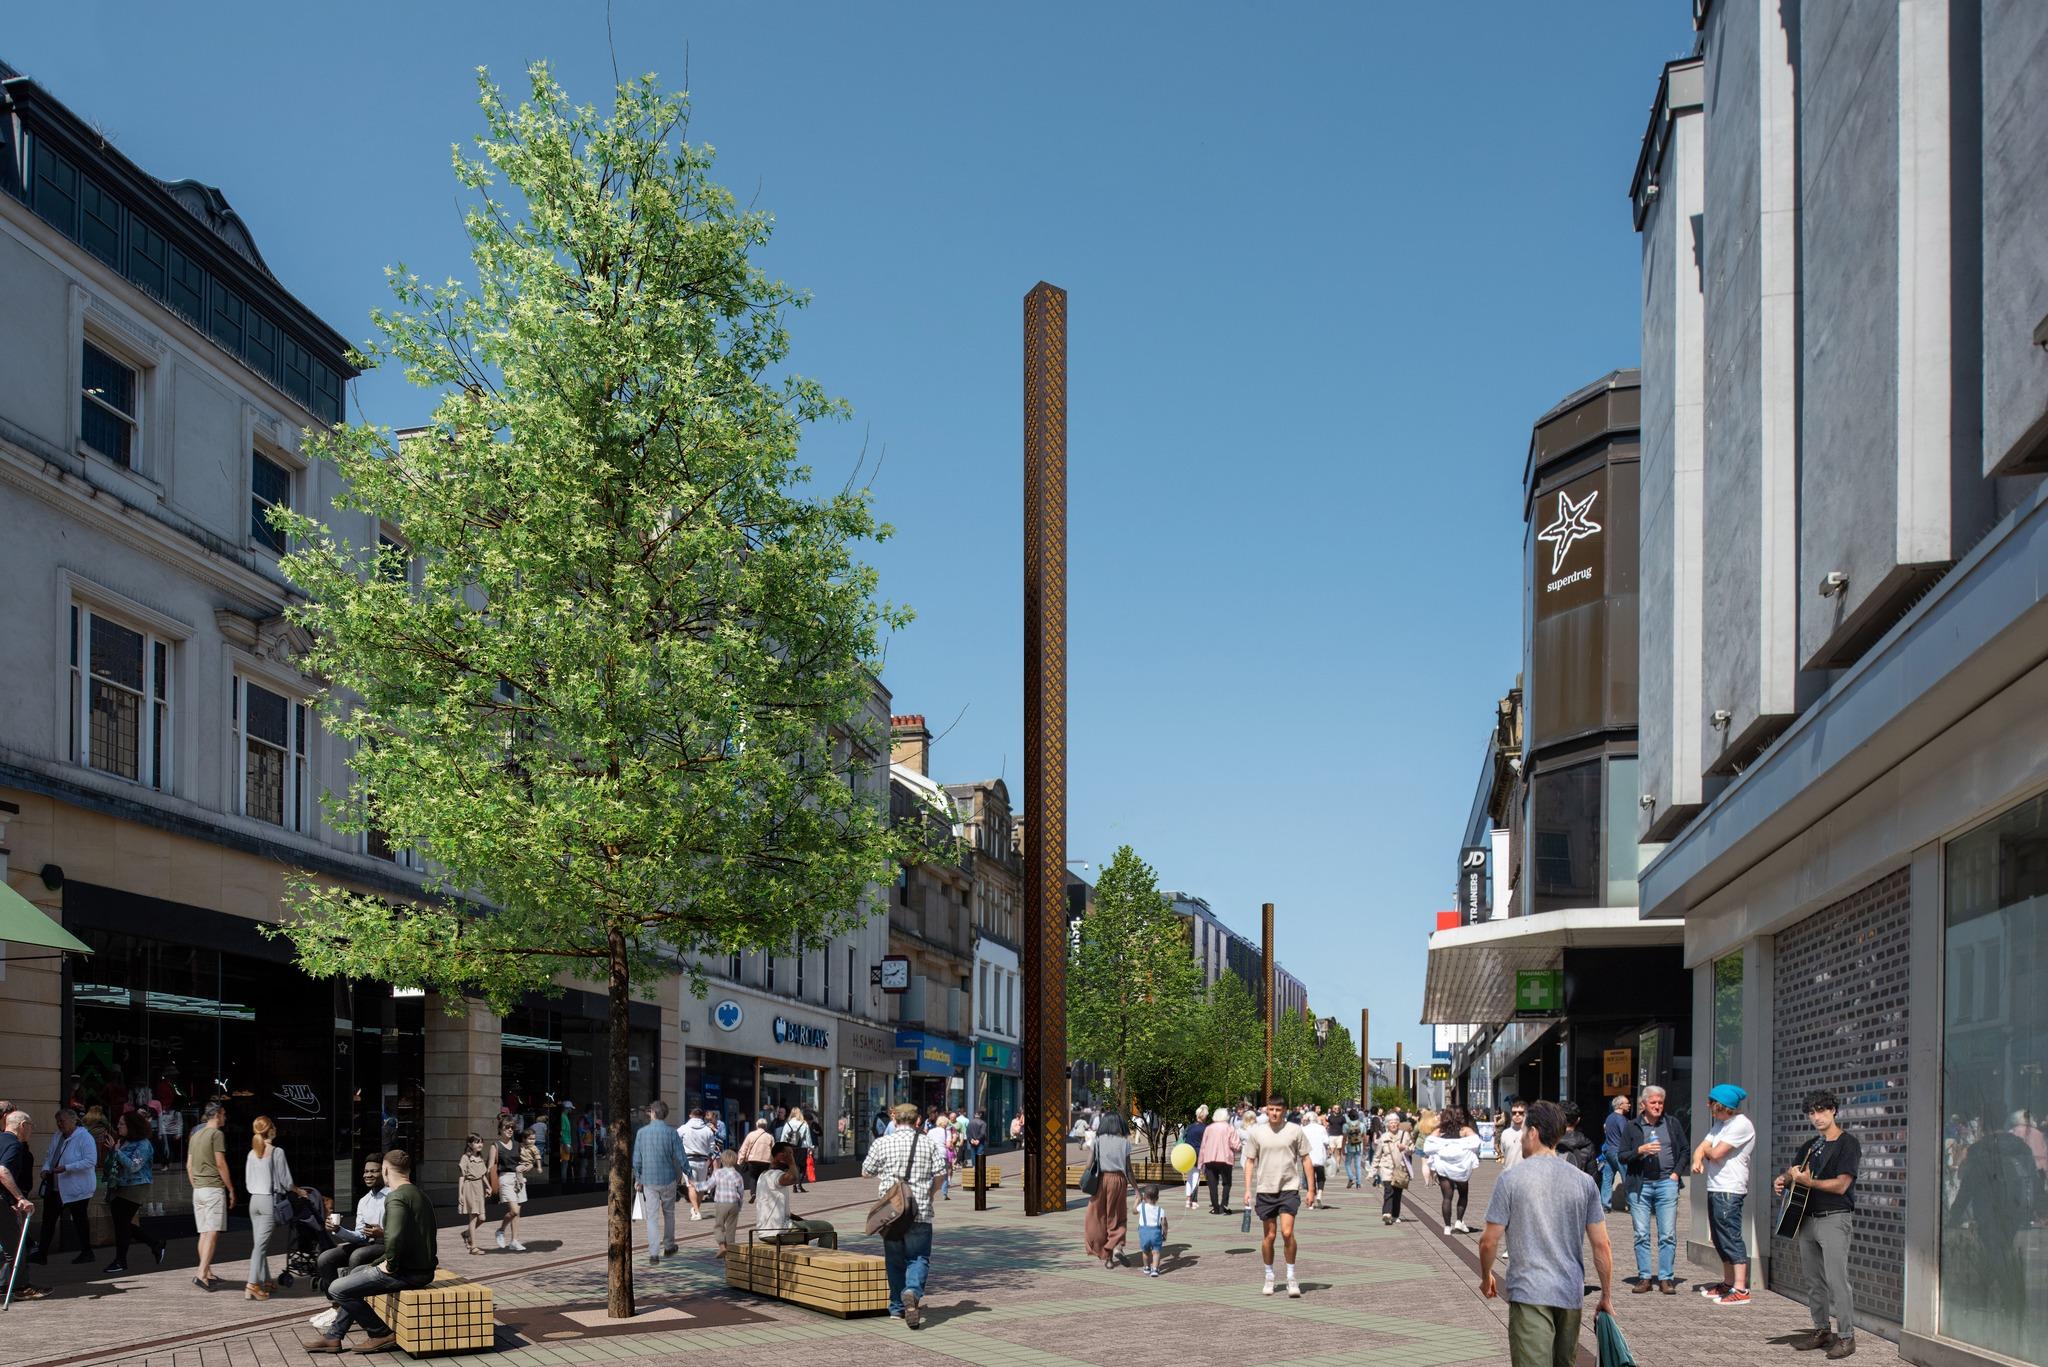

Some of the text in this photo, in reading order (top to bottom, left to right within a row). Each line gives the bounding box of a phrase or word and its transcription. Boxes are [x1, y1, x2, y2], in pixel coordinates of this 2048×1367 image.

[1547, 567, 1593, 592] superdrug
[1464, 851, 1485, 868] JD
[1470, 873, 1478, 920] TRAINERS
[787, 1022, 830, 1049] BARCLAYS
